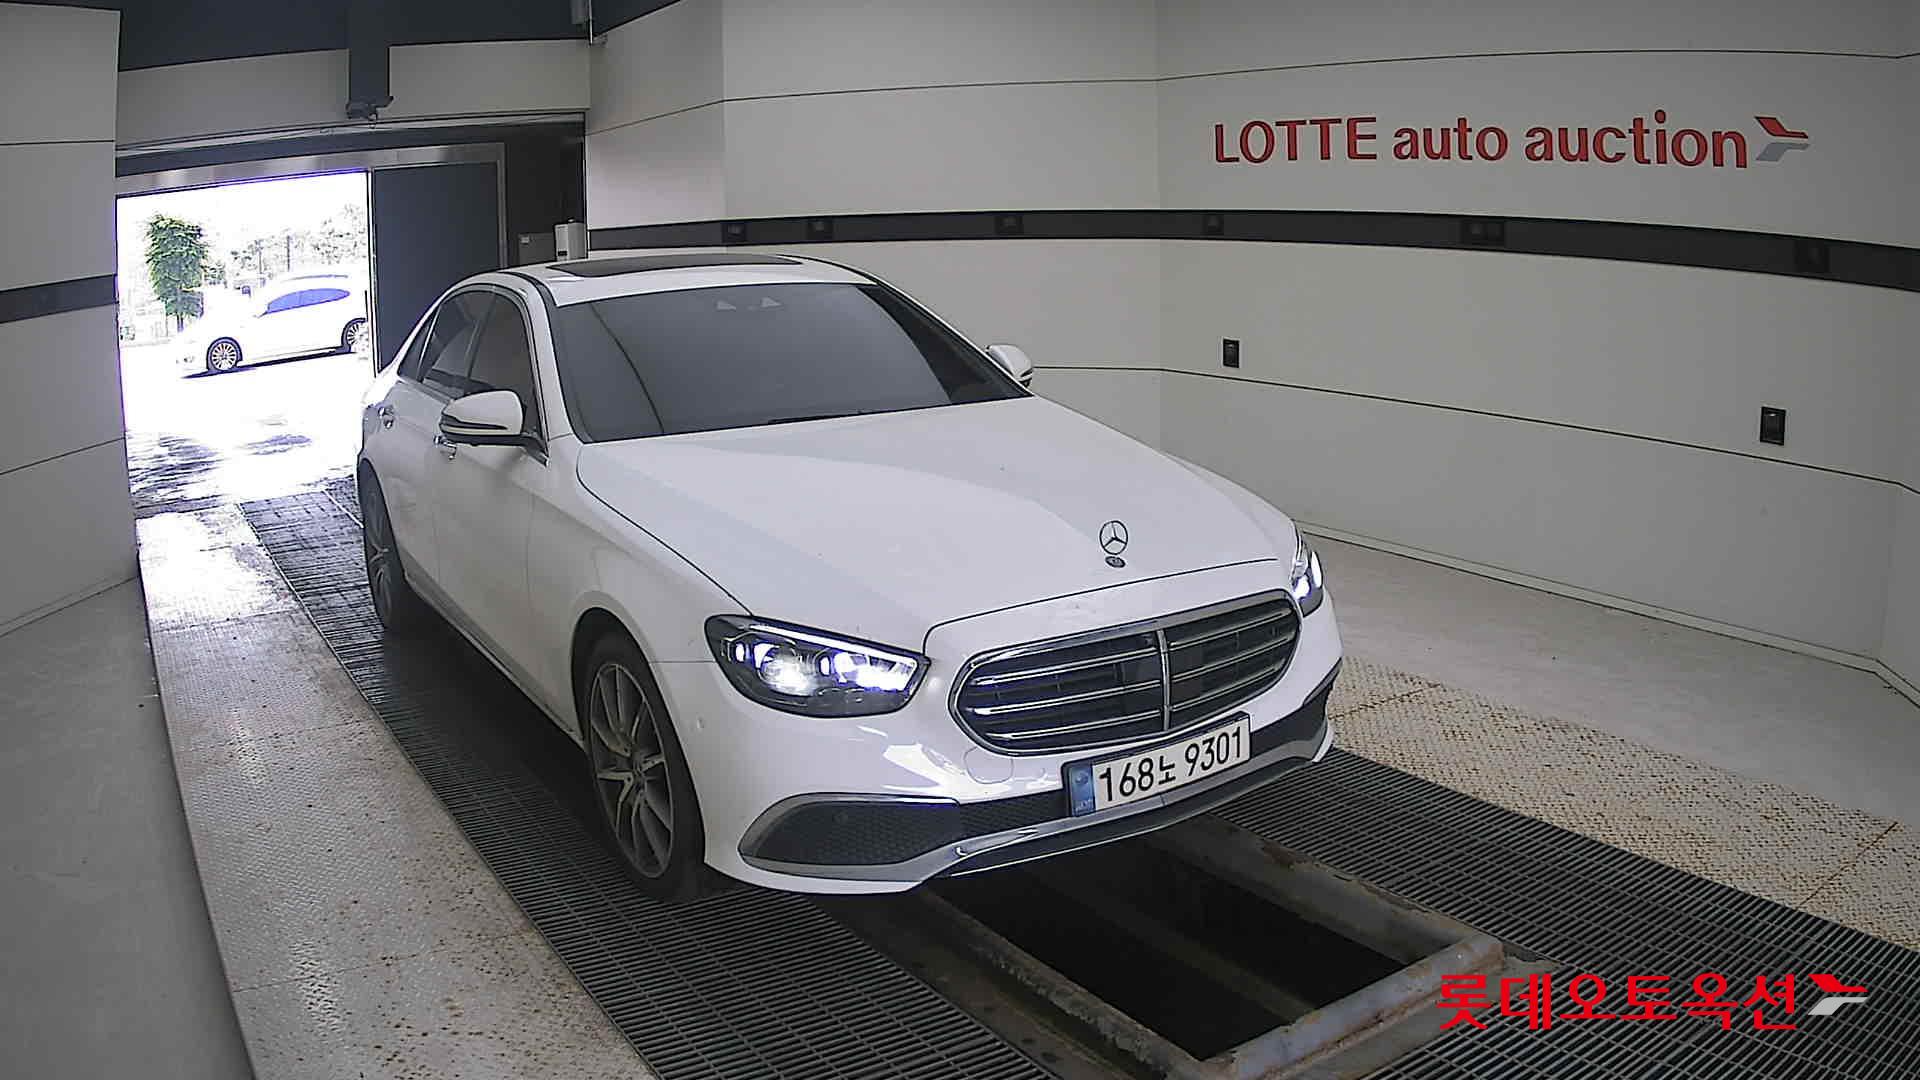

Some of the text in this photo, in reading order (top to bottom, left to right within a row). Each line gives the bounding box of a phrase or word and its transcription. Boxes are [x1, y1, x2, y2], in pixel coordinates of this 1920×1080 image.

[1214, 109, 1748, 169] LOTTE auto auction
[1099, 726, 1241, 802] 168노 9301
